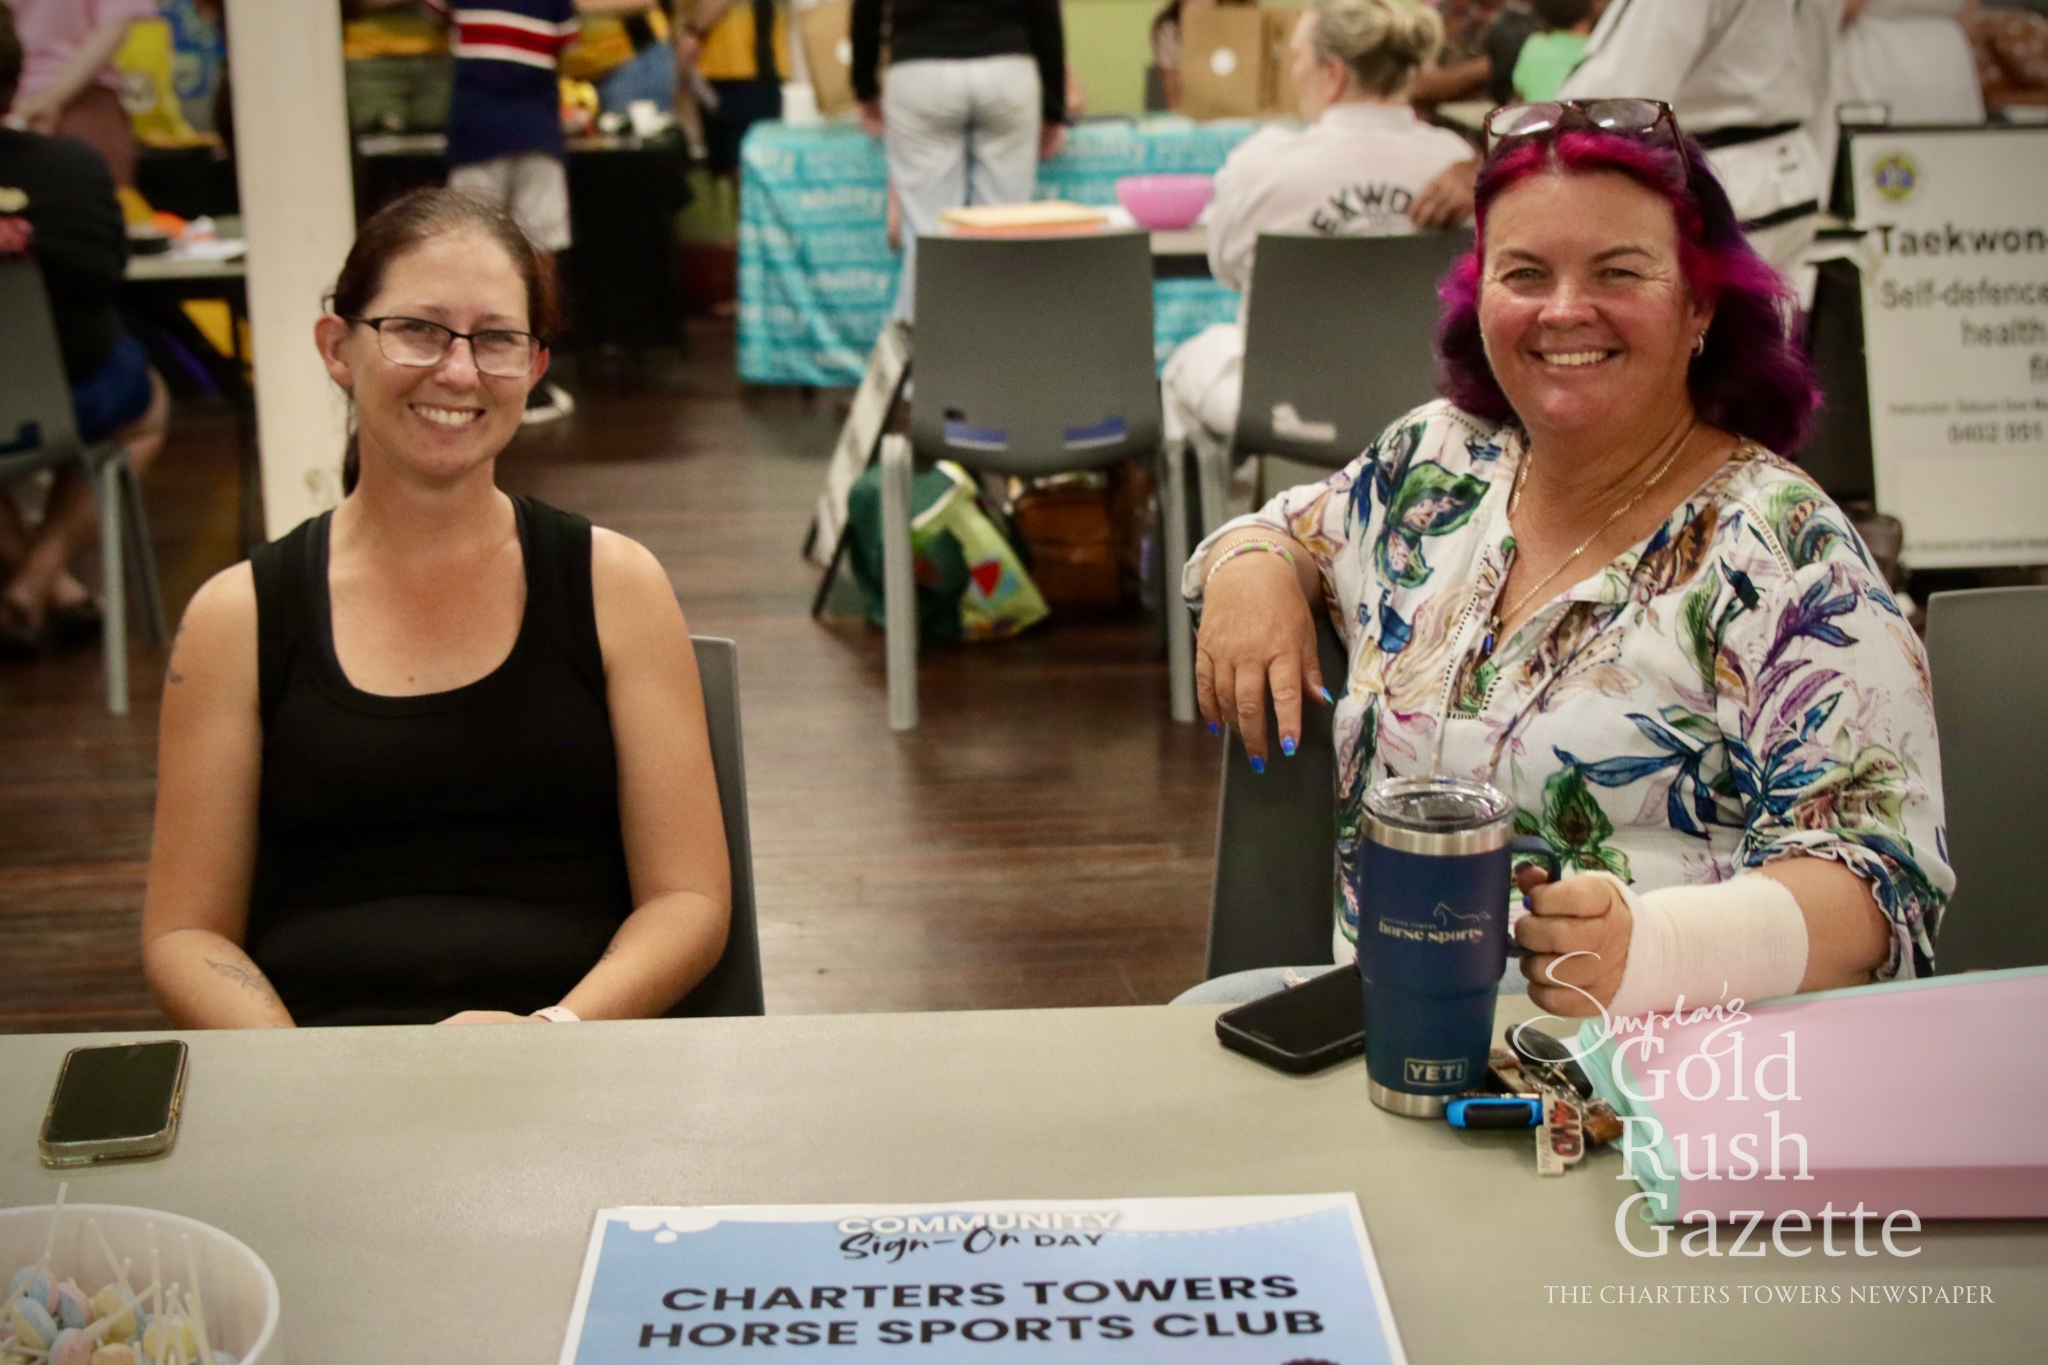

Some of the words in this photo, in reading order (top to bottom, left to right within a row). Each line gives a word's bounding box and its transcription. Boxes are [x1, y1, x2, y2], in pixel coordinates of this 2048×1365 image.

[1379, 919, 1424, 941] horse
[1427, 927, 1483, 945] sports
[1408, 1062, 1463, 1081] YETI
[837, 1211, 1120, 1234] COMMUNITY
[839, 1225, 1020, 1264] Sign-On
[1034, 1234, 1104, 1248] DAY
[661, 1282, 1006, 1312] CHARTERS
[1022, 1275, 1299, 1305] TOWERS
[638, 1319, 859, 1348] HORSE
[877, 1313, 1135, 1344] SPORTS
[1152, 1308, 1325, 1338] CLUB
